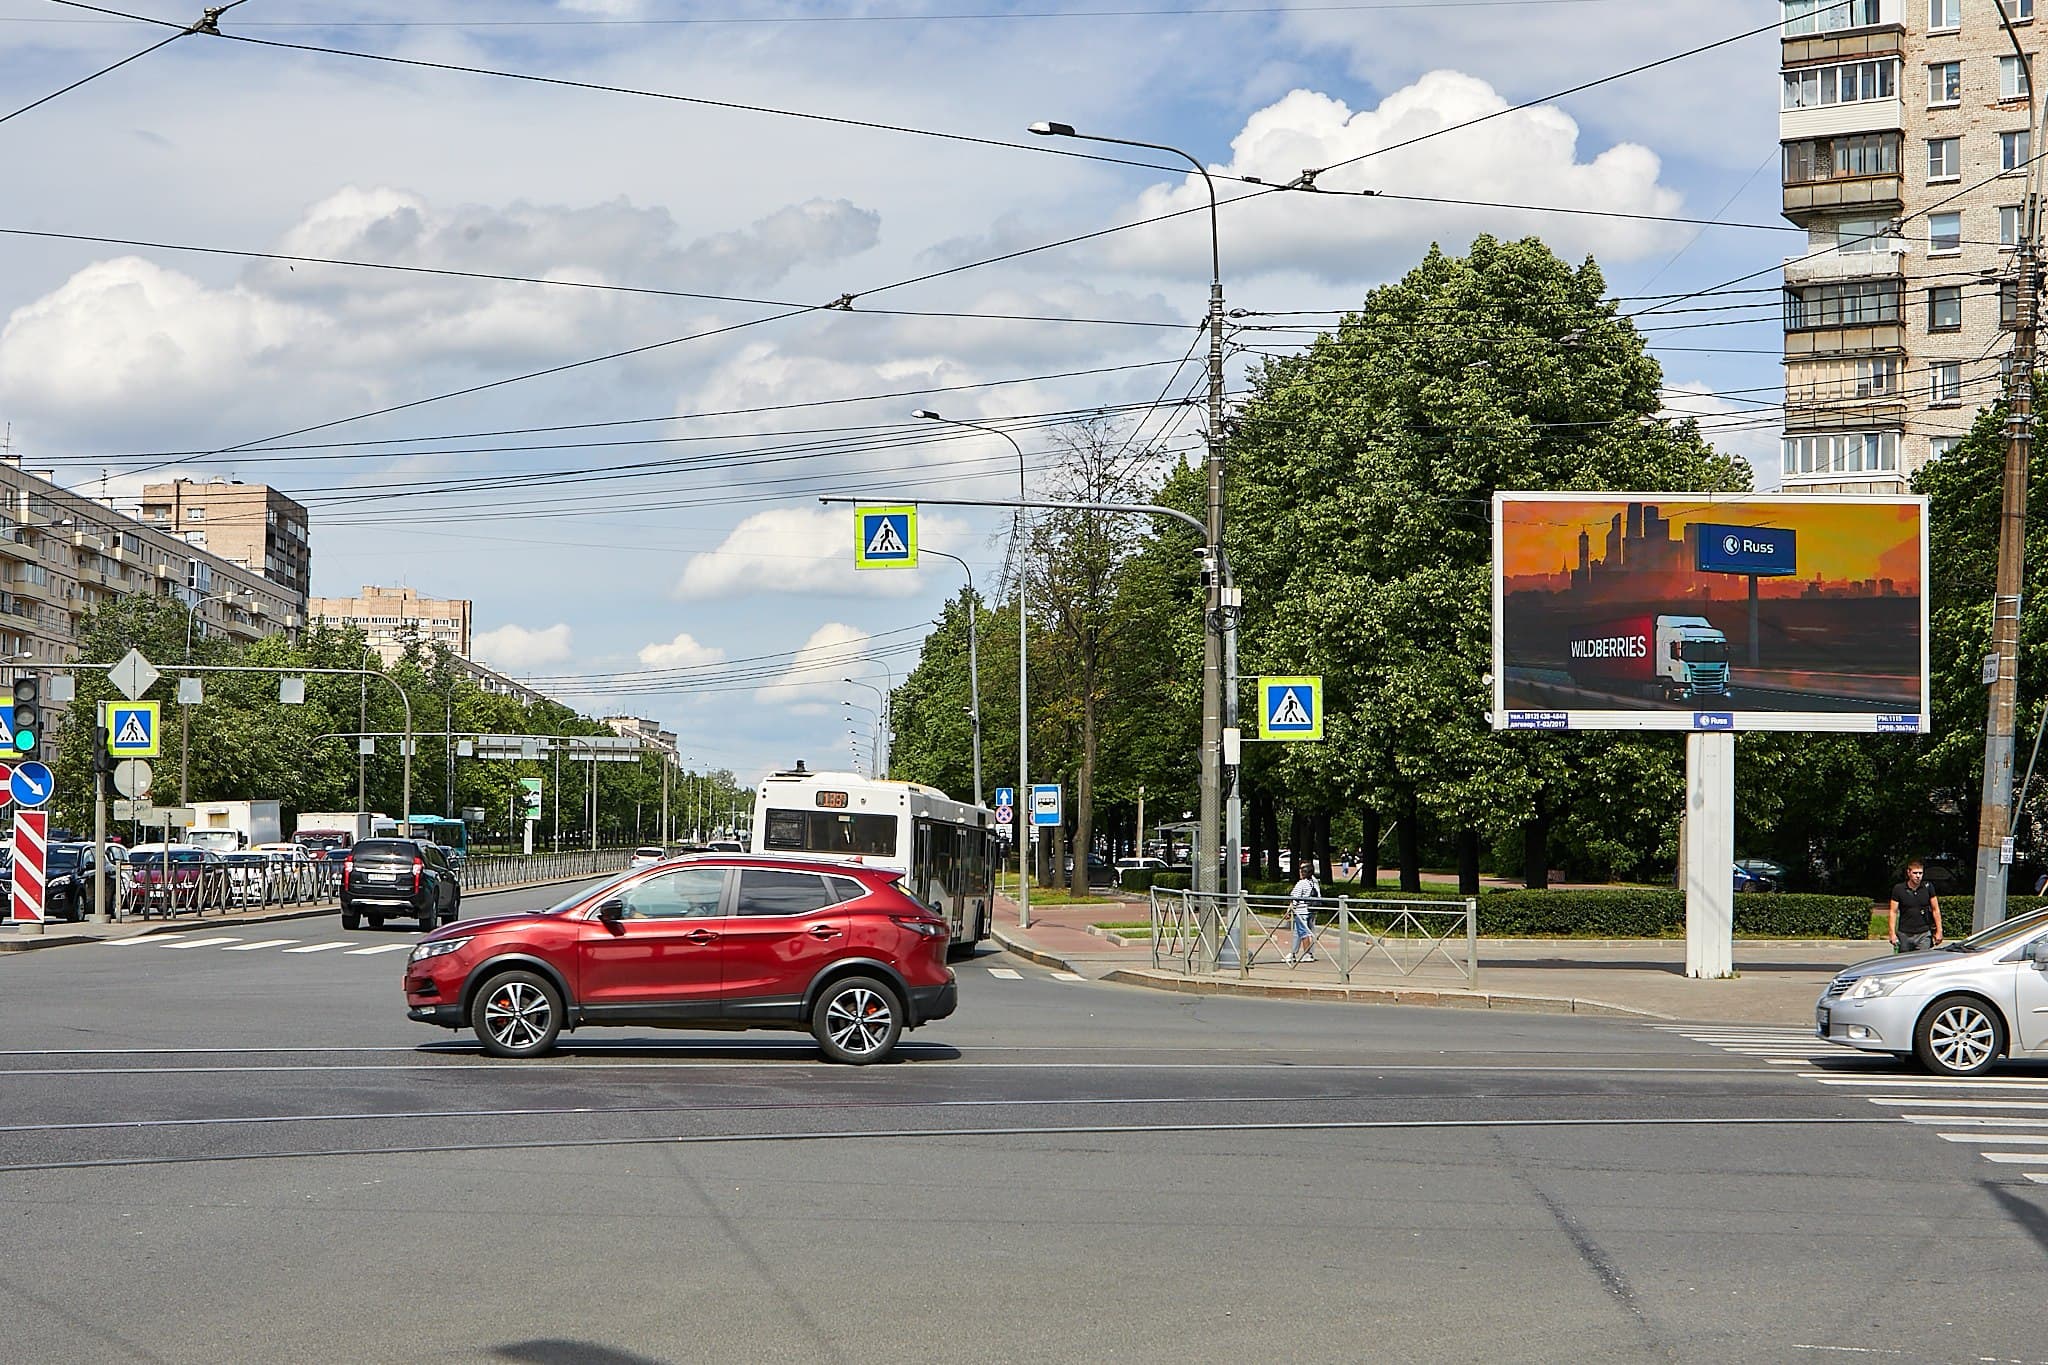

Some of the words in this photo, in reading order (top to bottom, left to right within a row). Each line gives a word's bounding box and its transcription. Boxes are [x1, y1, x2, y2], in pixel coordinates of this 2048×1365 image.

[1743, 539, 1774, 554] Russ
[1571, 635, 1647, 658] WILDBERRIES
[1711, 717, 1729, 726] Russ
